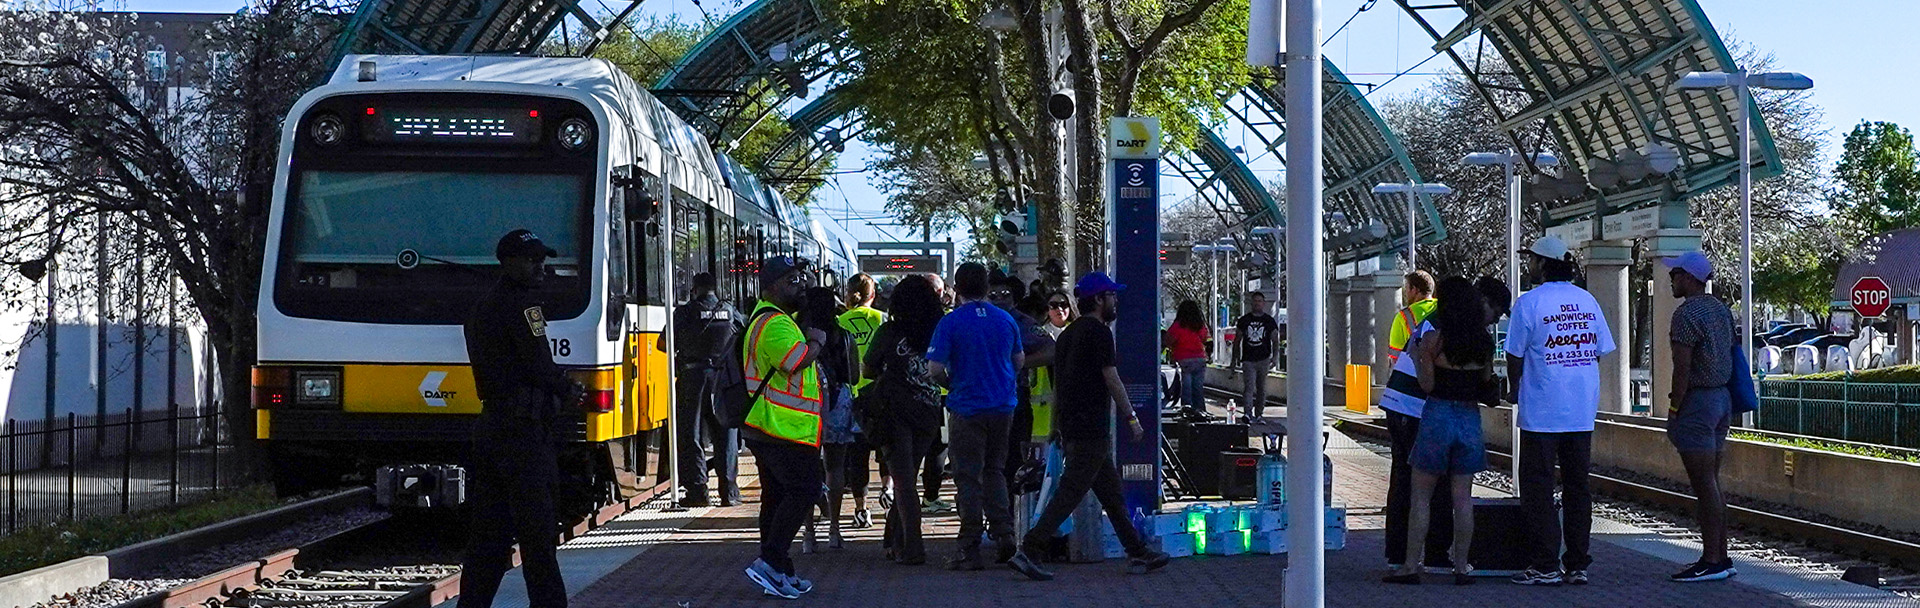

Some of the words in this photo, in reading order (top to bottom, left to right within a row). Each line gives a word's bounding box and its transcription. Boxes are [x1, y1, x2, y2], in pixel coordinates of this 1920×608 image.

[1116, 139, 1147, 148] DART
[1853, 289, 1888, 306] STOP
[1560, 304, 1579, 313] DELI
[1556, 322, 1589, 331] COFFEE
[1545, 351, 1563, 360] 214
[1566, 350, 1582, 358] 233
[424, 390, 457, 399] DART
